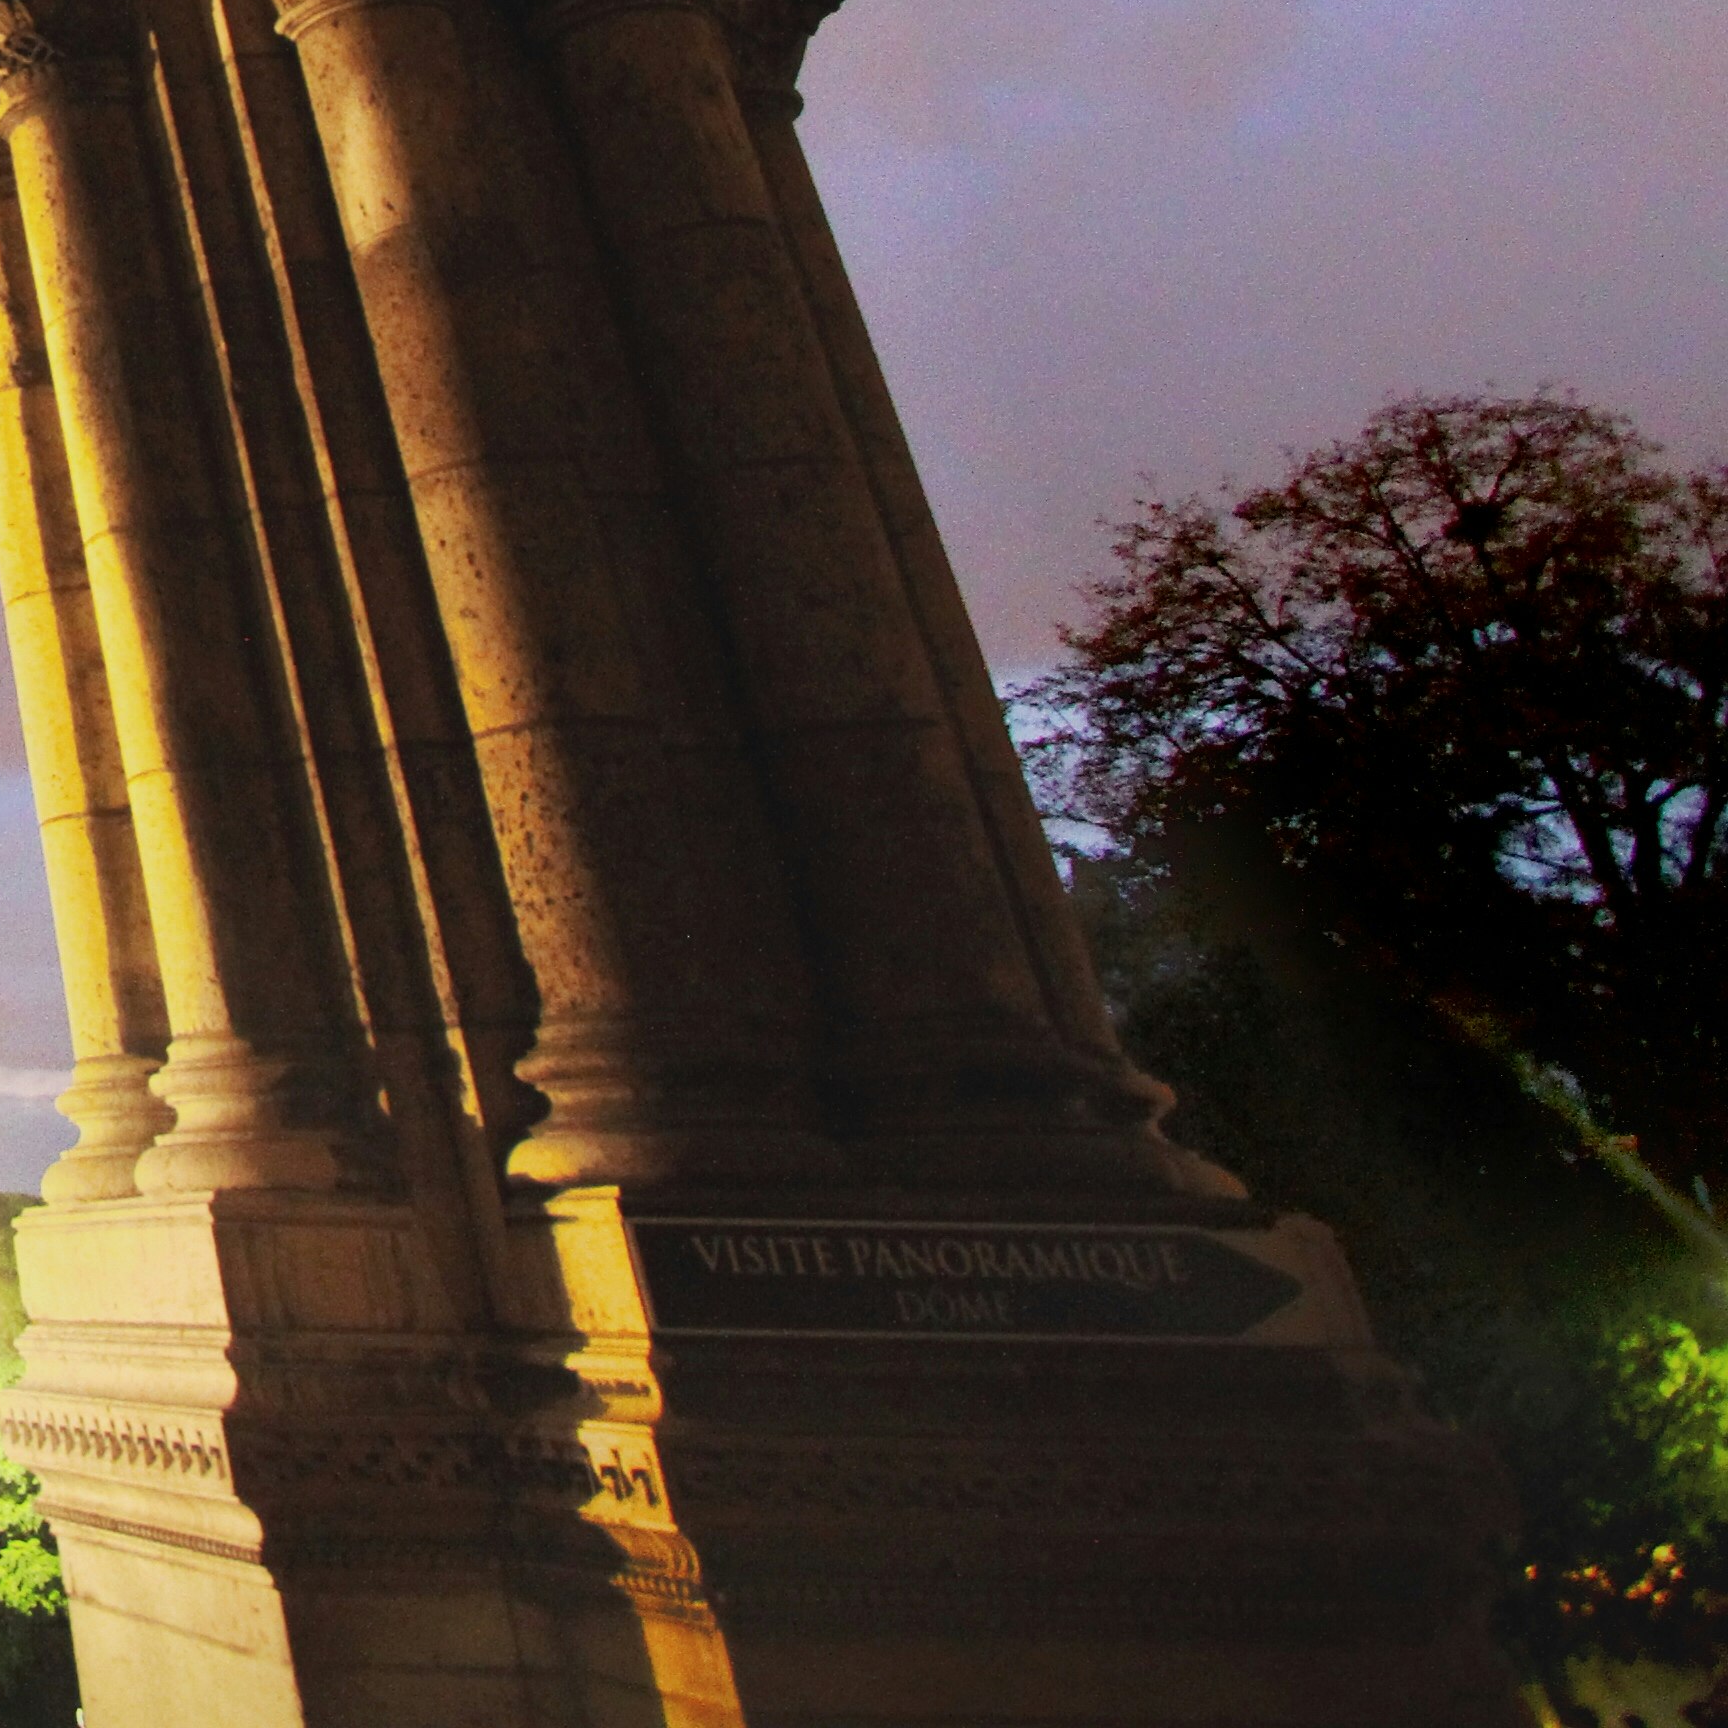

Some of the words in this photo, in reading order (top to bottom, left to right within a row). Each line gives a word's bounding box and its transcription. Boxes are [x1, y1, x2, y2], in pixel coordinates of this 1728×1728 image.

[693, 1234, 839, 1277] VISITE
[848, 1238, 1193, 1292] PANORAMIQUE
[894, 1284, 1010, 1325] DÔME
